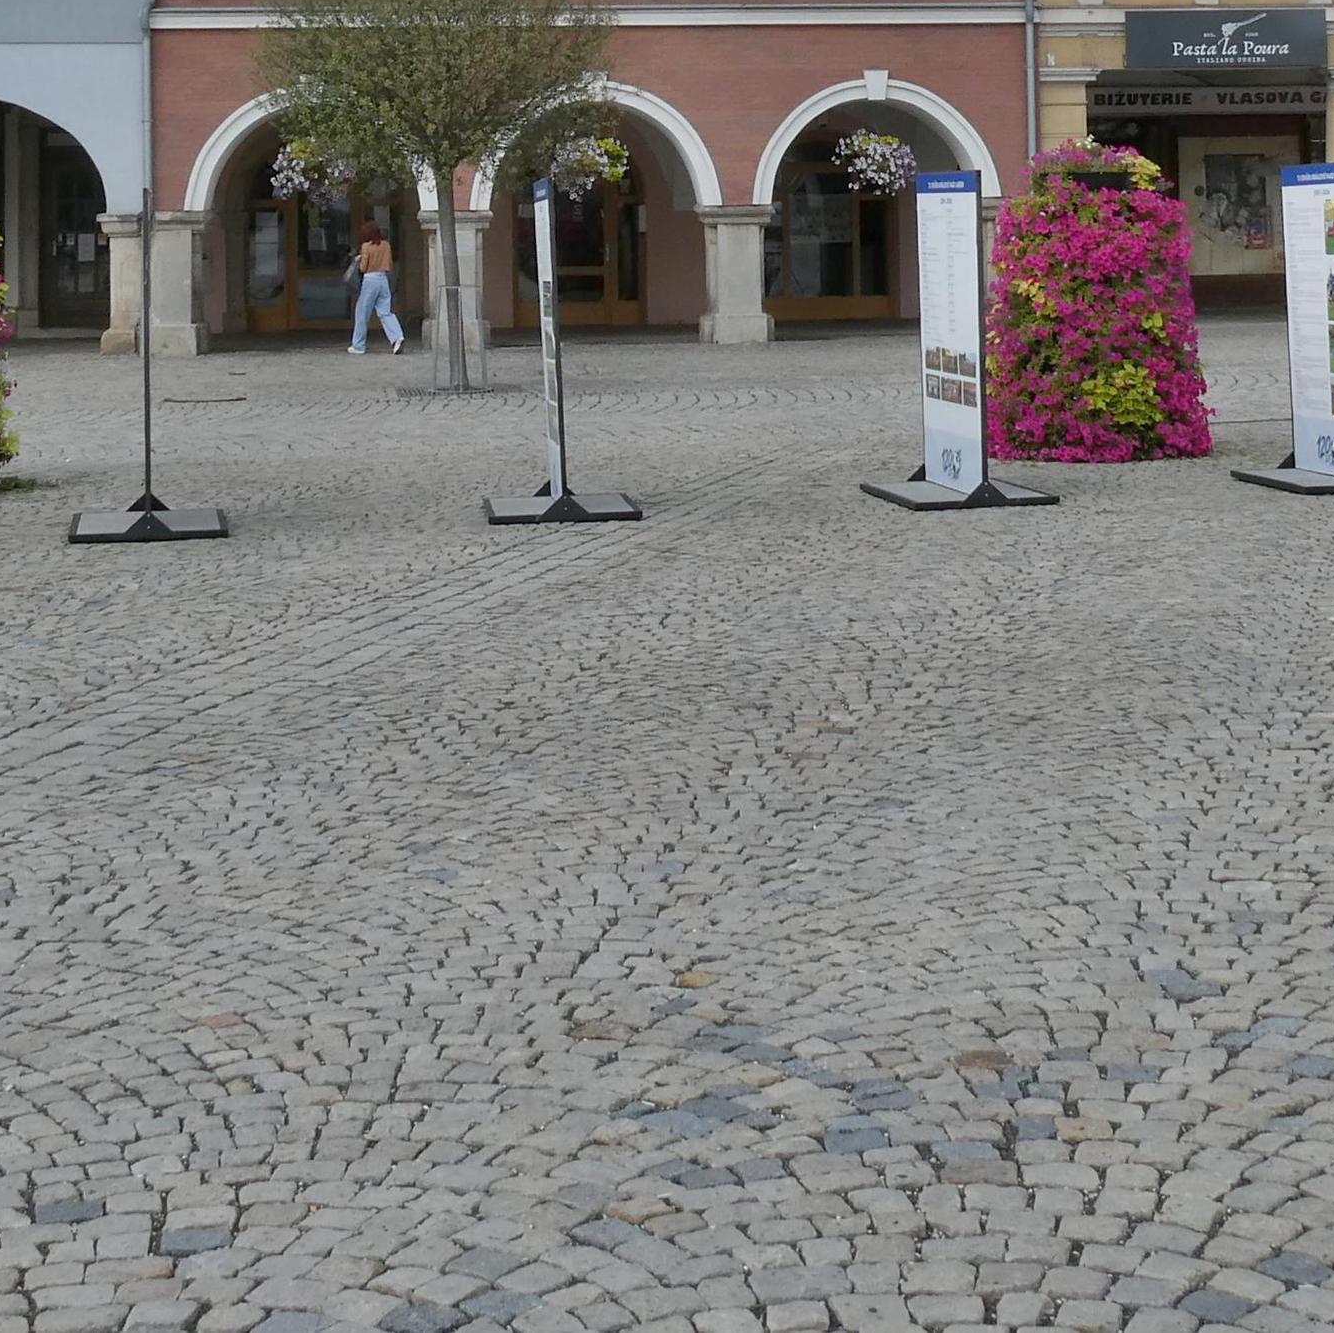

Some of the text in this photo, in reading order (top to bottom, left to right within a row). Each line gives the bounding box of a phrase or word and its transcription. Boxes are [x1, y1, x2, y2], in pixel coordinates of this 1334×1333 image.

[1171, 37, 1290, 56] Pasta la Poura
[1094, 91, 1192, 106] BIŽUTERIE
